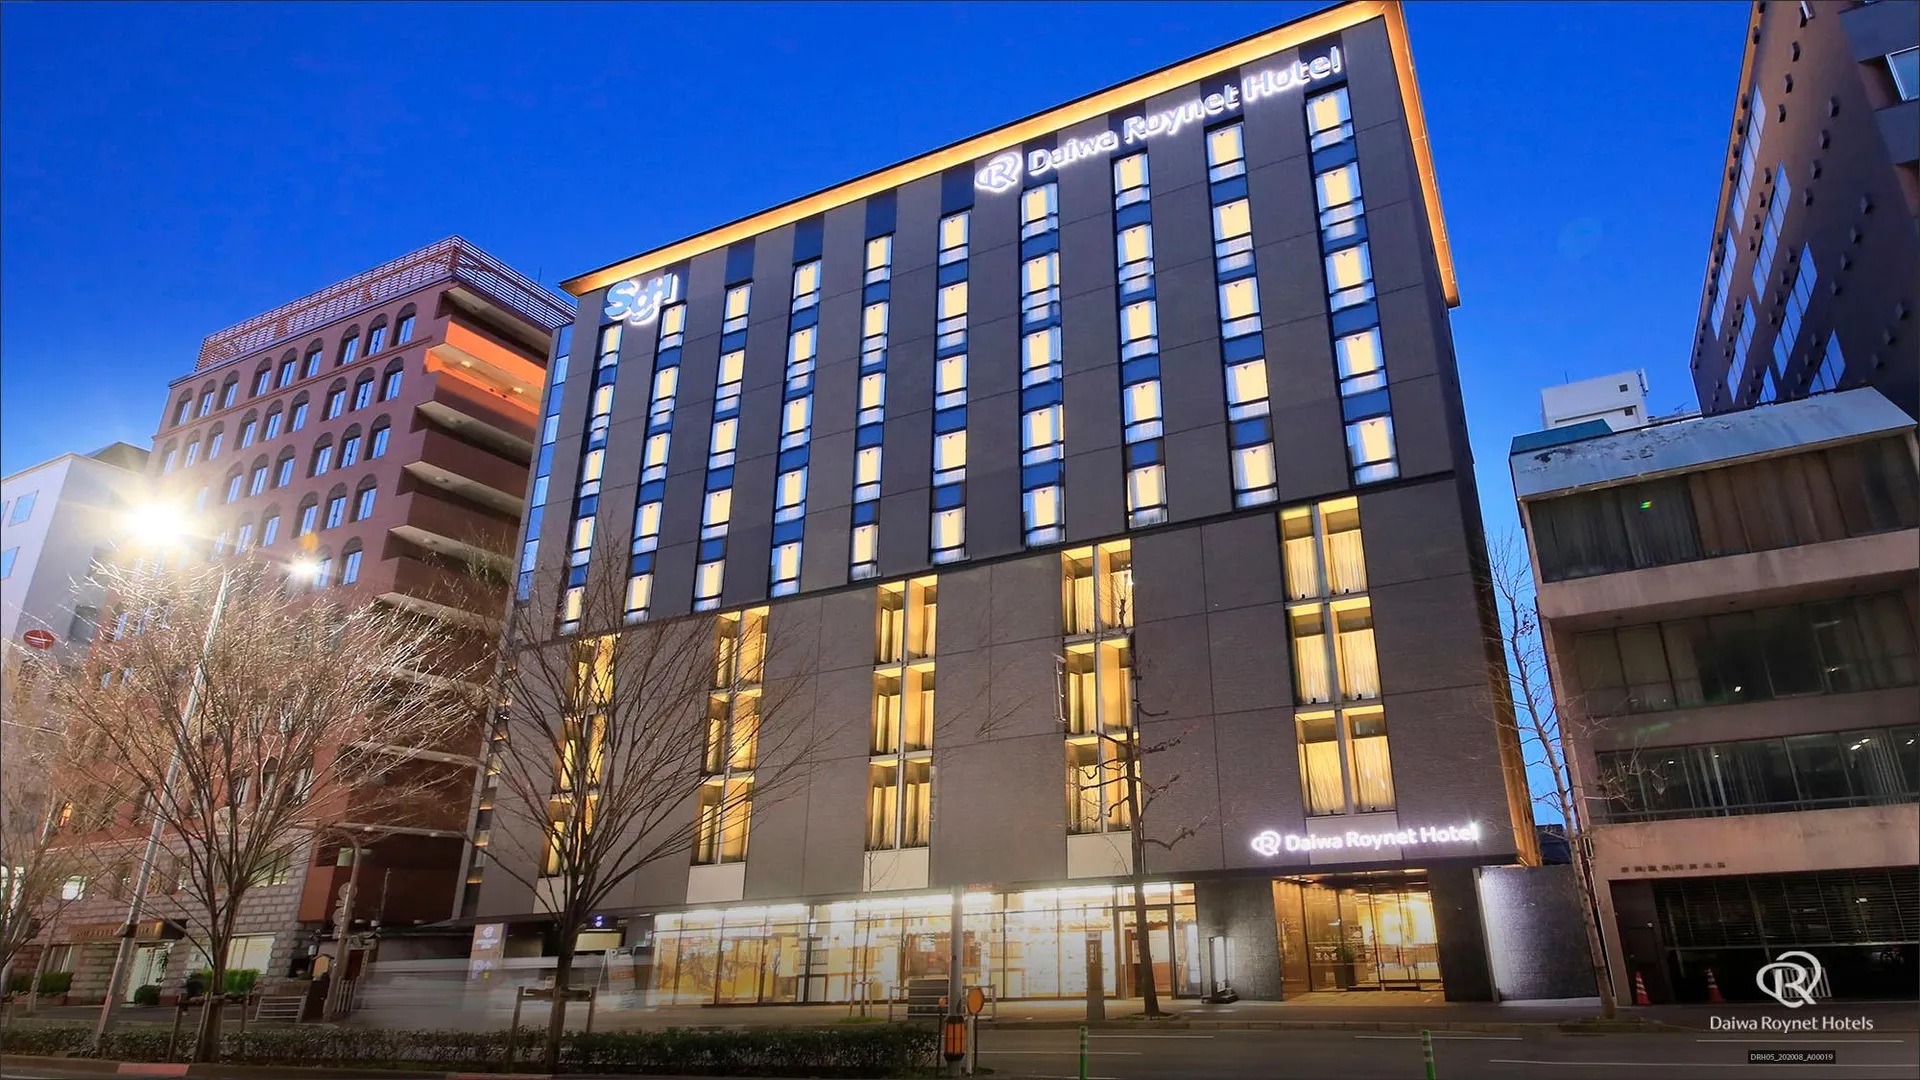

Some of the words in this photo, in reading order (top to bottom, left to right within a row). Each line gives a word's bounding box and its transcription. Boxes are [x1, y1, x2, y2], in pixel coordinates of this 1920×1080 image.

[1028, 130, 1118, 176] Daiwa
[1123, 83, 1240, 138] Roynet
[1243, 46, 1342, 103] Hotel
[1285, 834, 1342, 851] Daiwa
[1345, 830, 1417, 850] Roynet
[1420, 822, 1479, 844] Hotel
